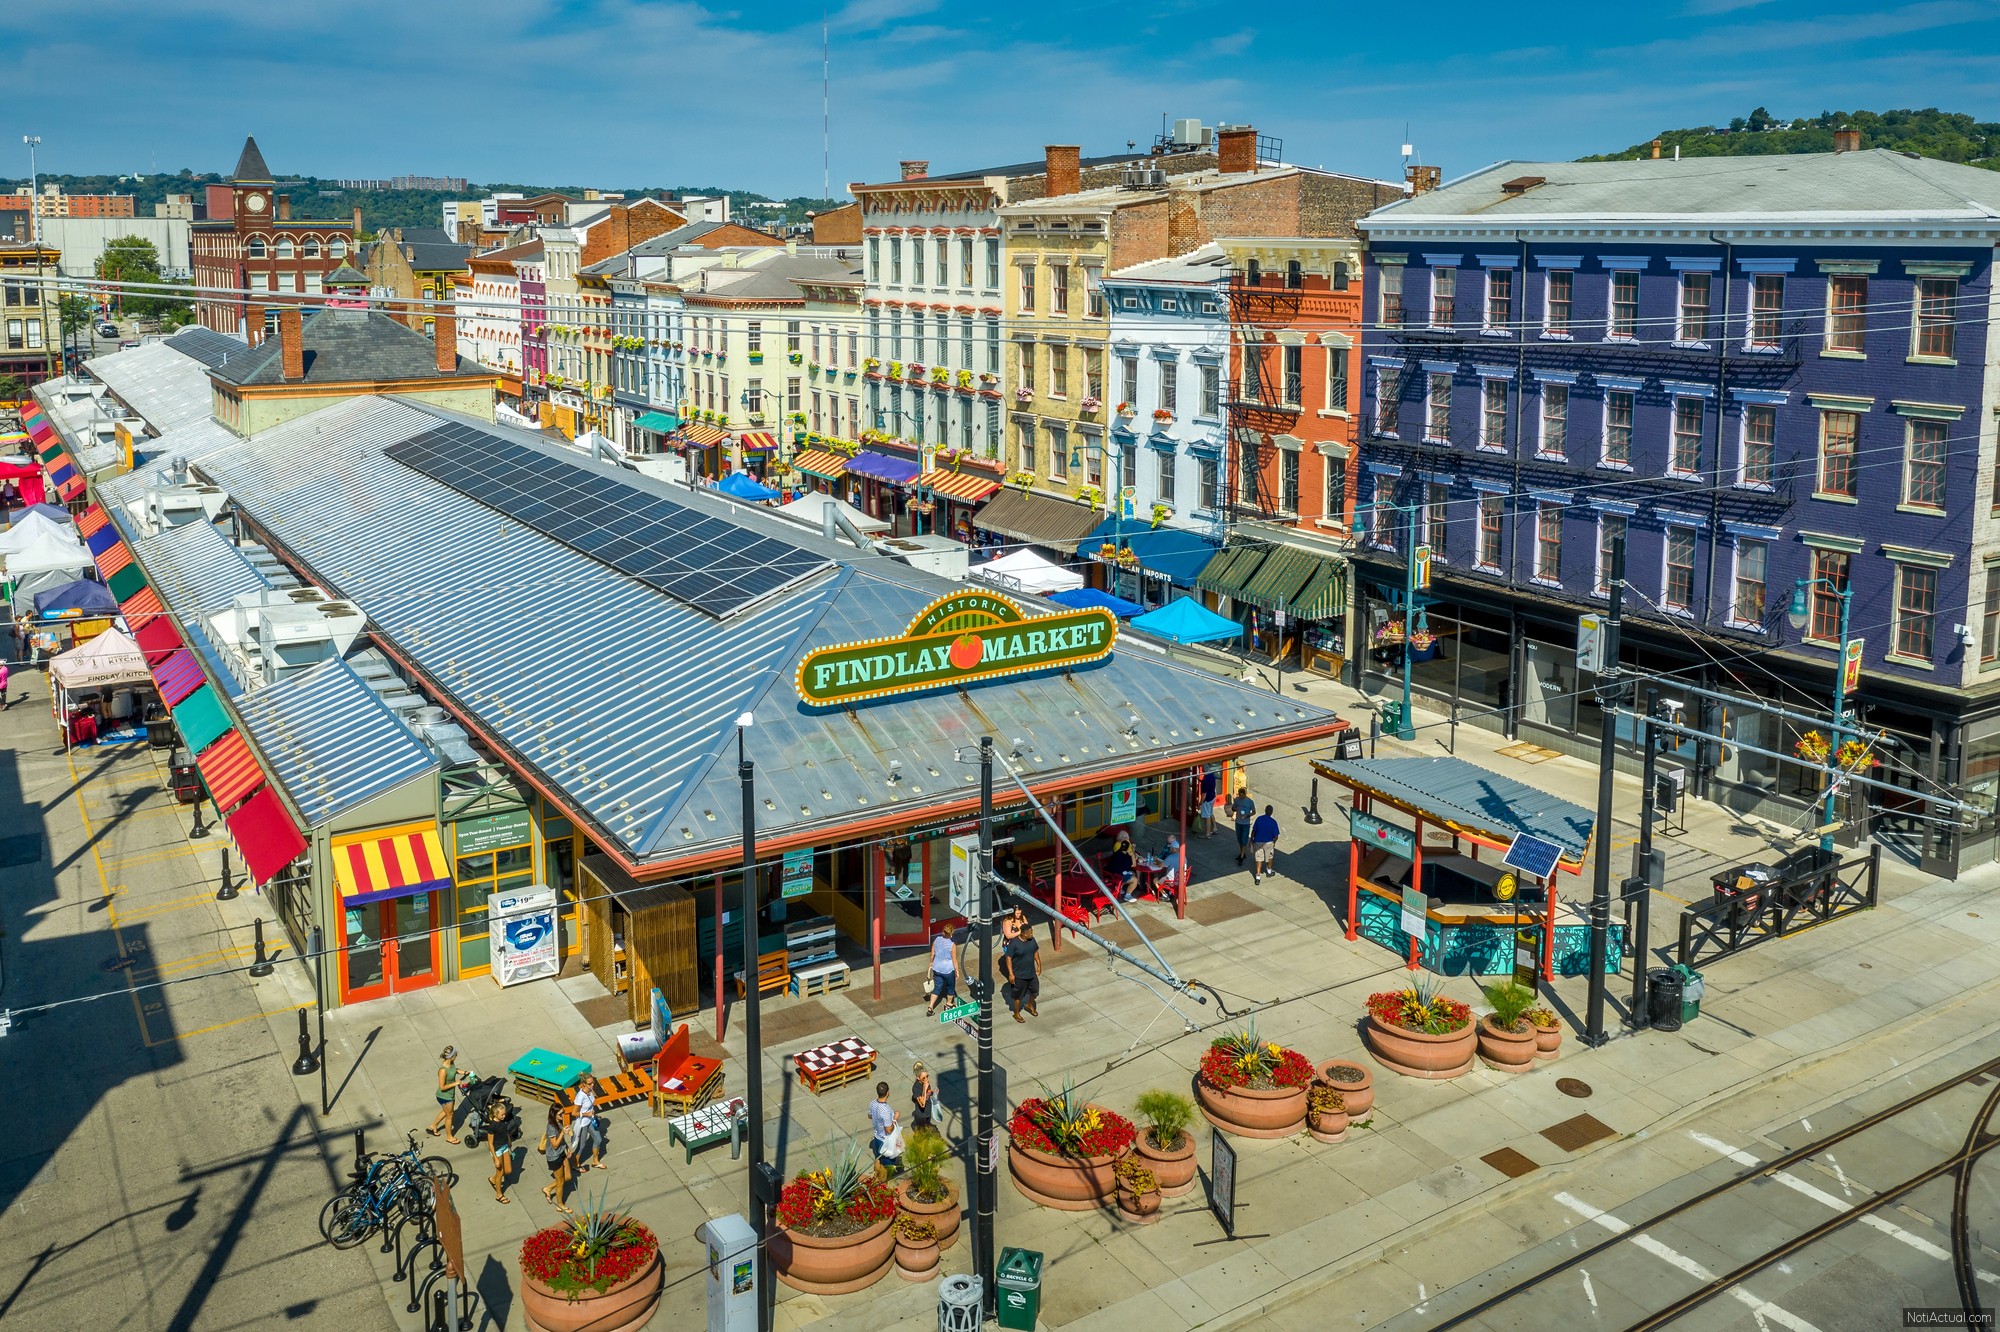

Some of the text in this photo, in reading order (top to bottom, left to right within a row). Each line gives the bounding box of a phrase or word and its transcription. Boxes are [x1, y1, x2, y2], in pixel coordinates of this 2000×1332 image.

[1143, 568, 1172, 582] IMPORTS
[927, 599, 1007, 626] HISTORIC
[813, 621, 1105, 690] FINDLAY MARKET
[87, 673, 120, 682] FINDLAY
[1539, 681, 1562, 692] MODERN
[1972, 781, 1990, 793] MODERN
[943, 1009, 962, 1021] Race
